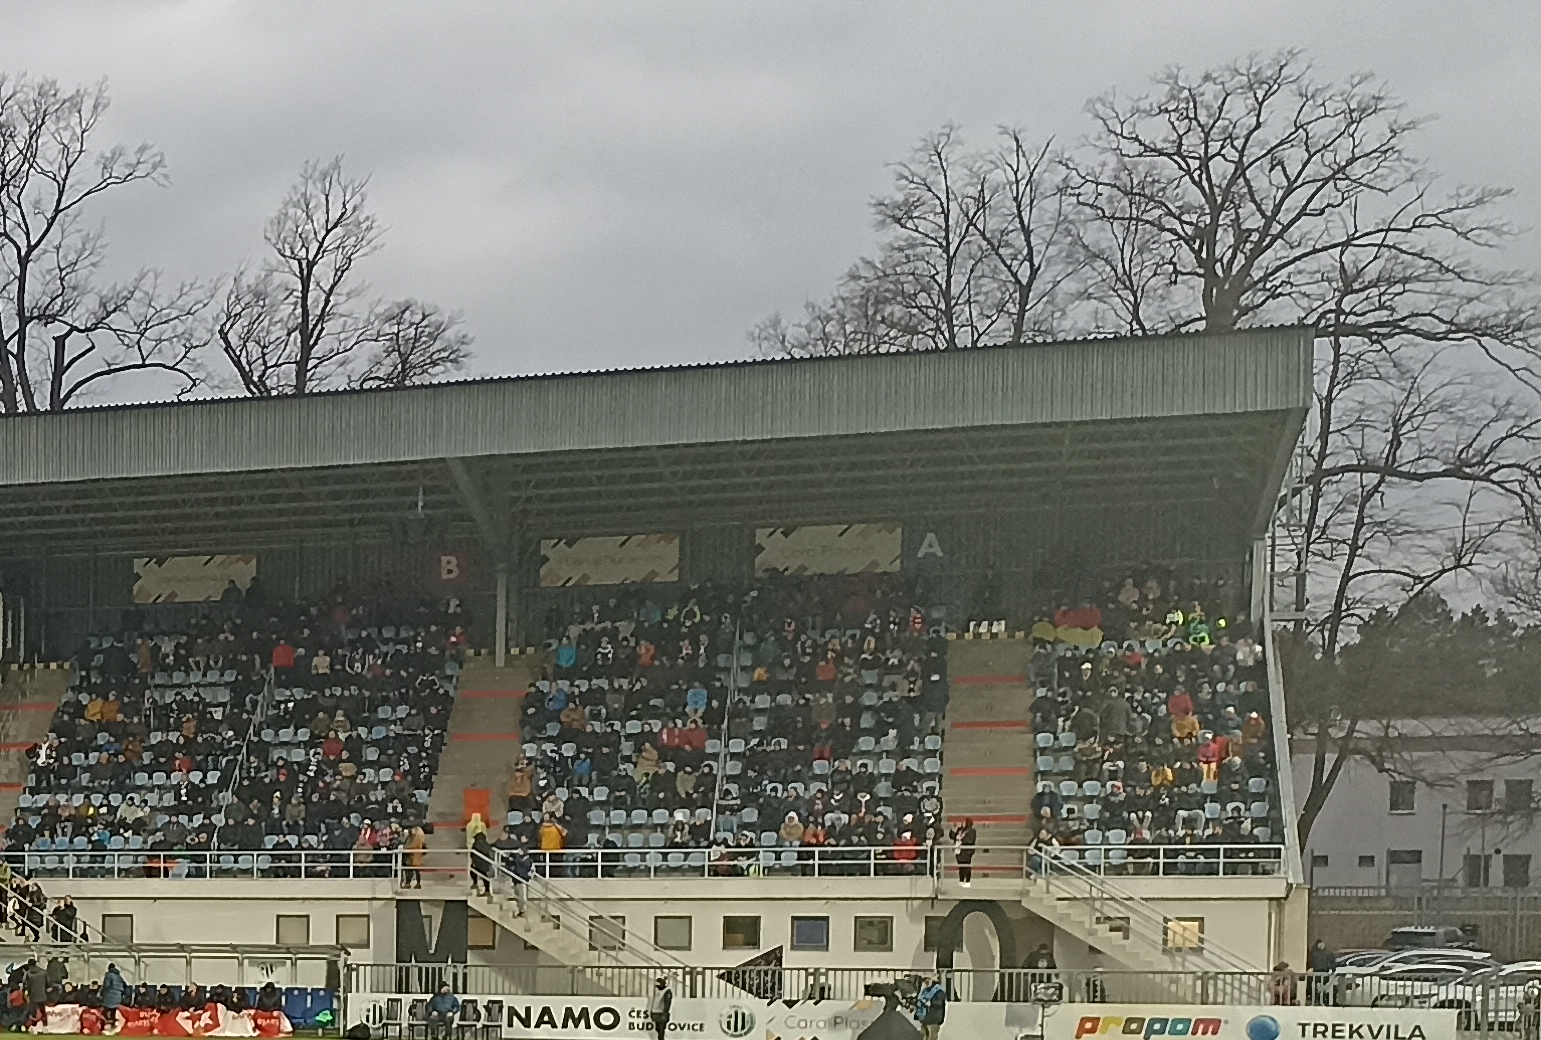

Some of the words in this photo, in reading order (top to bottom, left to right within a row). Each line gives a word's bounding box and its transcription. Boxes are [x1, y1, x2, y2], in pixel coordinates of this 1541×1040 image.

[917, 532, 944, 558] A
[440, 555, 460, 580] B
[628, 1007, 650, 1019] ČES
[784, 1015, 827, 1030] Cara
[833, 1014, 869, 1030] Plas
[628, 1021, 705, 1032] BUDOVICE
[1075, 1016, 1222, 1040] propom
[1297, 1022, 1426, 1040] TREKVILA
